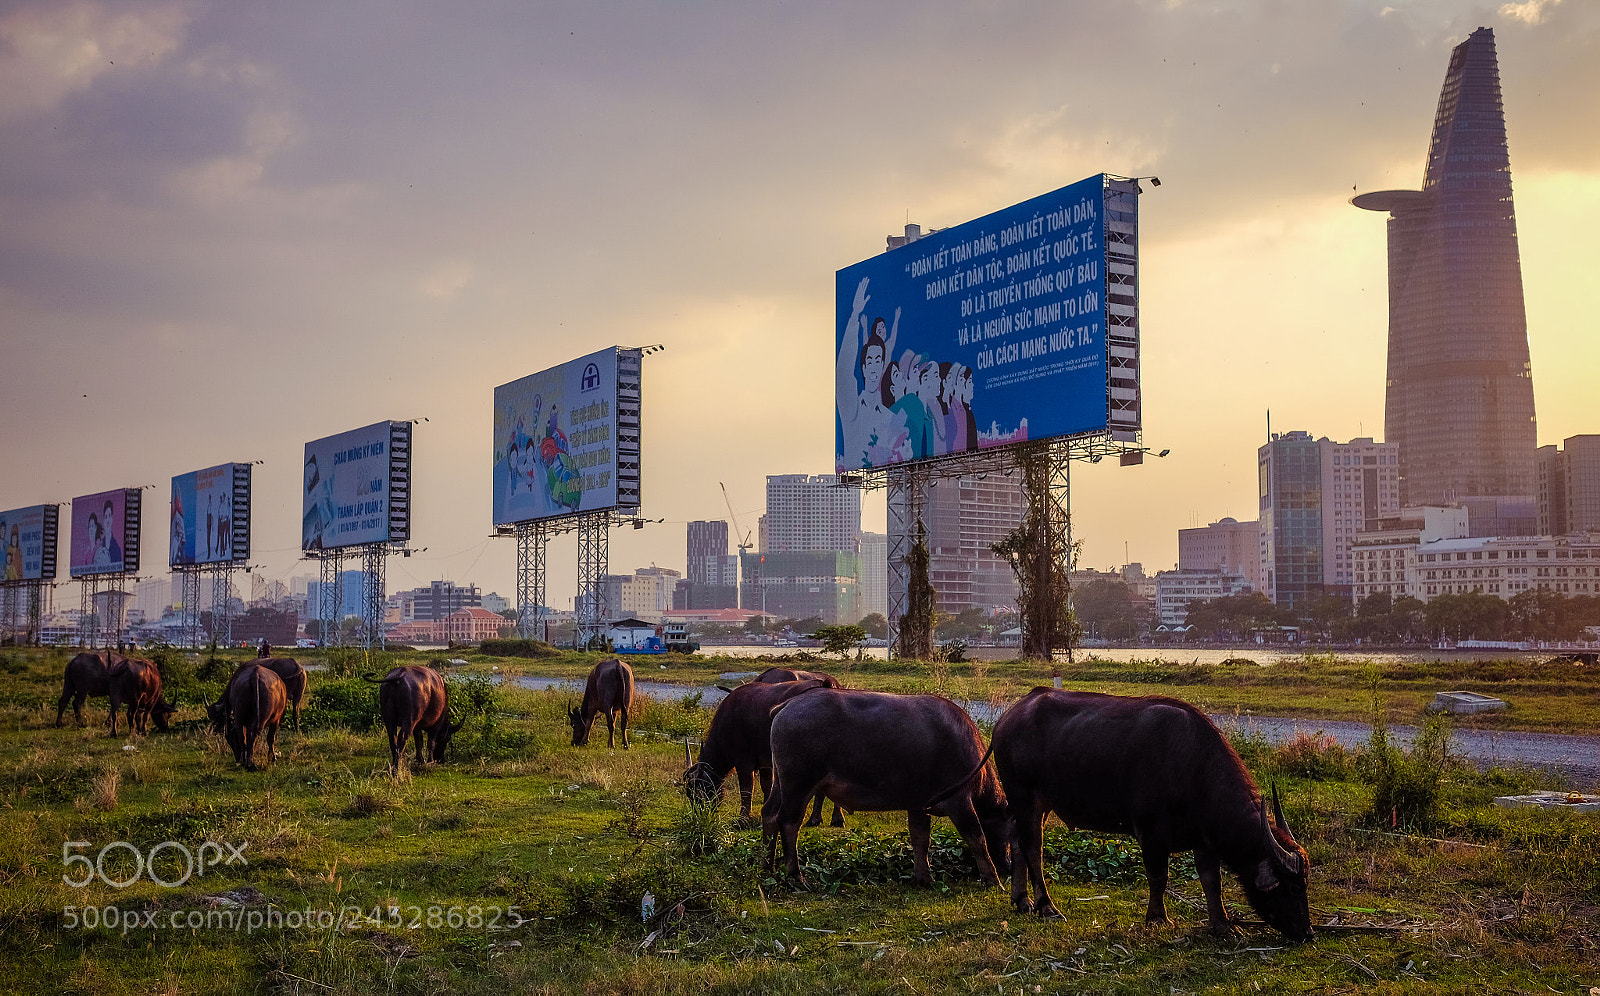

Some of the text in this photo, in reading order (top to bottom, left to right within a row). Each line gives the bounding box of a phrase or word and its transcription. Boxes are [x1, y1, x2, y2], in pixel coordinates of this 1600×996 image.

[926, 223, 1097, 300] ĐOÀN KẾT DÂN TỘC, ĐOÀN KẾT QUỐC TẾ.
[934, 244, 948, 271] KẾT
[951, 239, 971, 263] TOÀN
[974, 230, 999, 257] ĐẢNG,
[1001, 221, 1024, 248] ĐOÀN
[1027, 211, 1043, 238] KẾT
[1046, 205, 1071, 233] TOÀN
[1074, 197, 1097, 224] DÂN,
[961, 258, 1098, 317] ĐÓ LÀ TRUYỀN THỐNG QUÝ BÁU
[958, 290, 1098, 346] VÀ LÀ NGUỒN SỨC MẠNH TO LỚN
[978, 344, 994, 370] CỦA
[996, 340, 1019, 365] CÁCH
[1022, 336, 1047, 361] MẠNG
[1050, 326, 1074, 353] NƯỚC
[379, 500, 383, 512] 2
